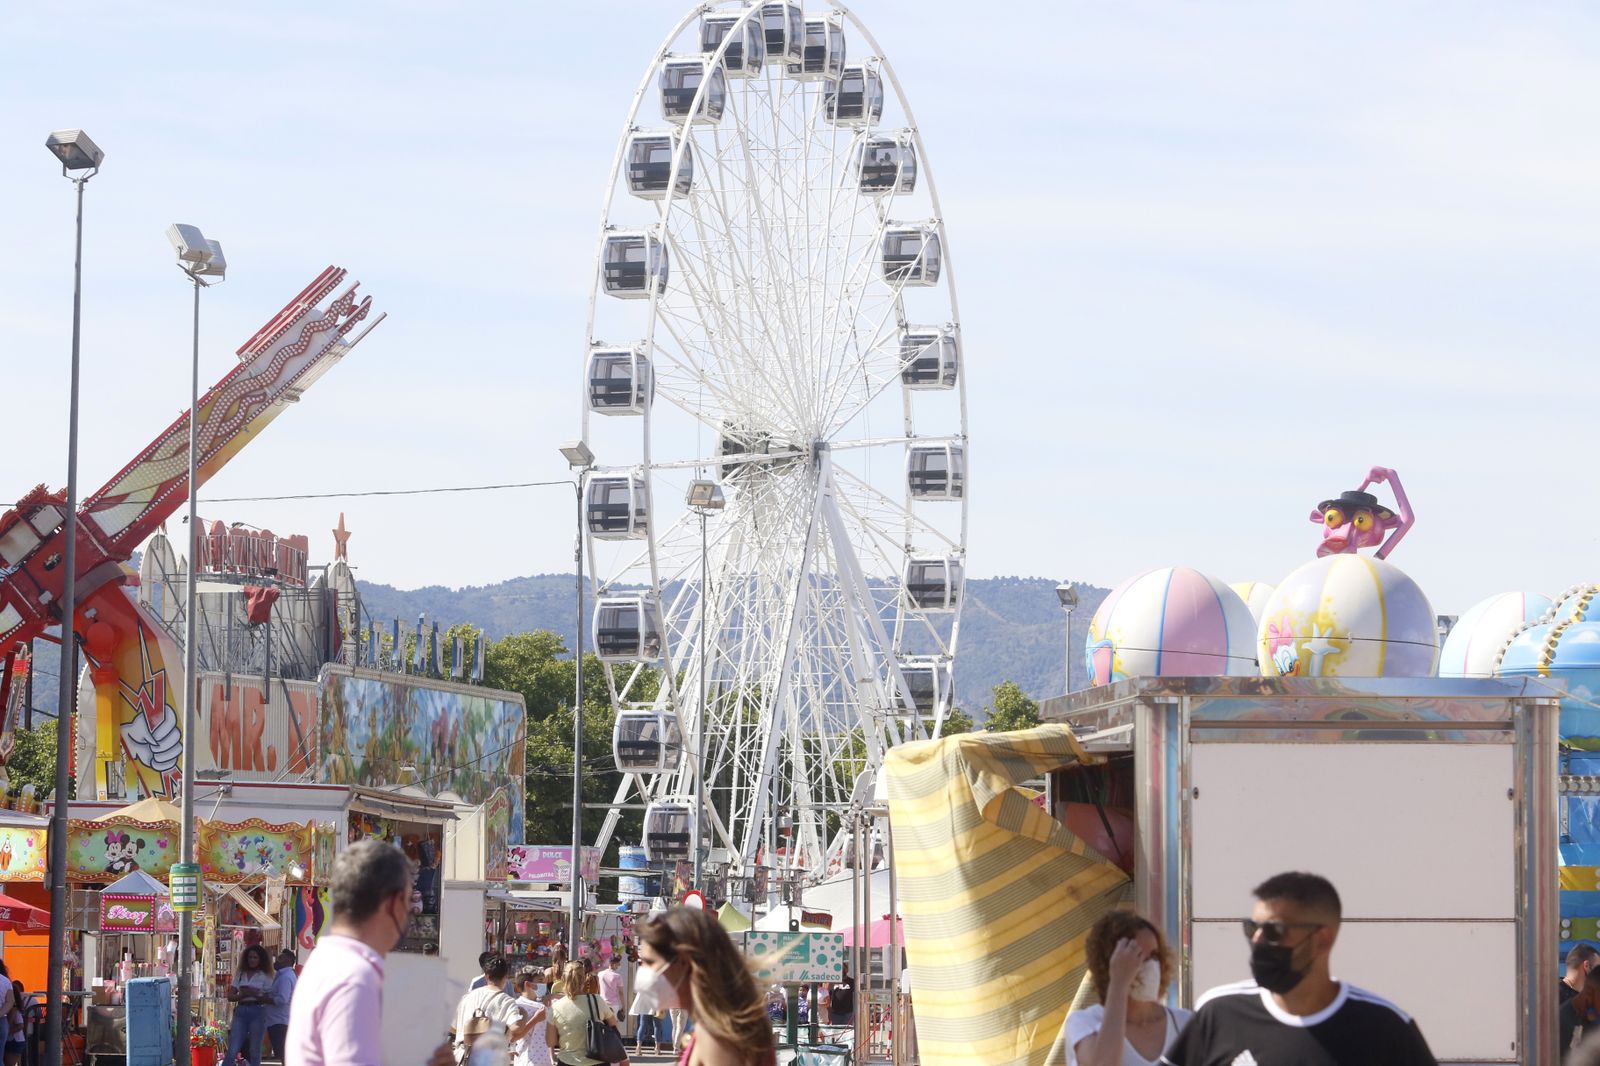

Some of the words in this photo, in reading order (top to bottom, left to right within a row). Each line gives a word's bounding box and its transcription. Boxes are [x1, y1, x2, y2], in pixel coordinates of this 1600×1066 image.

[211, 684, 276, 772] MR.
[542, 851, 563, 859] DULCE
[811, 972, 840, 980] sadeco
